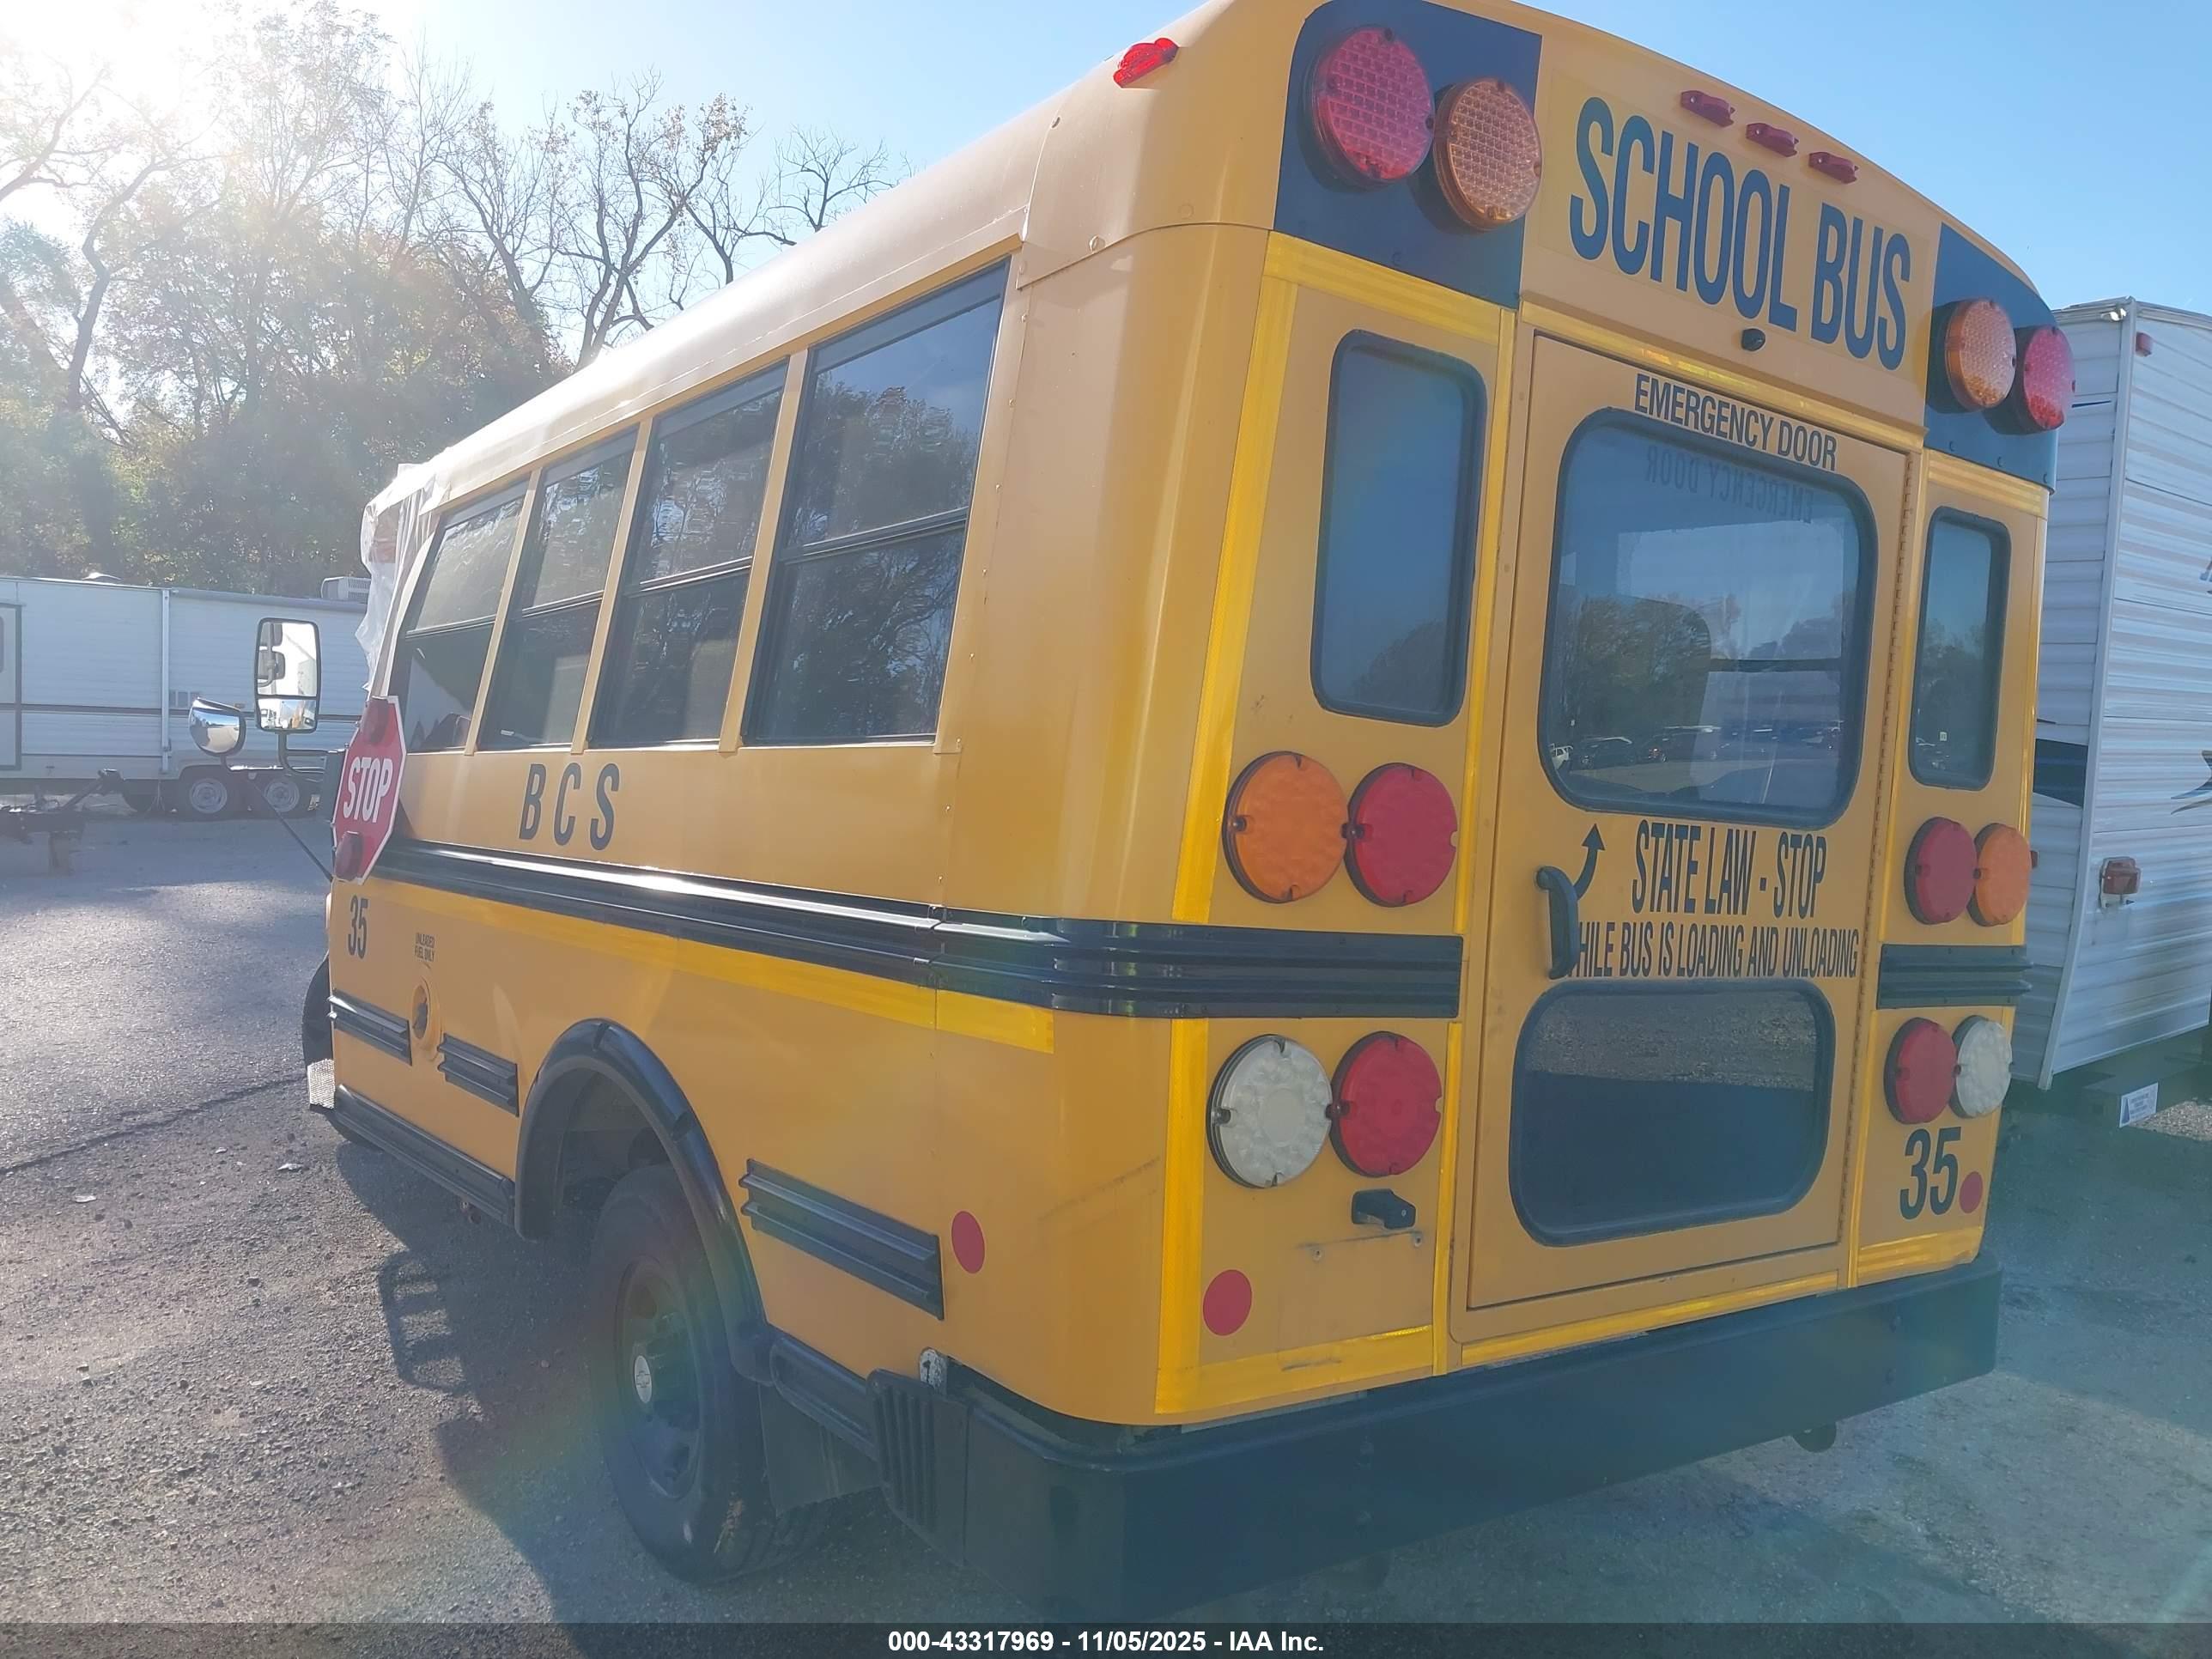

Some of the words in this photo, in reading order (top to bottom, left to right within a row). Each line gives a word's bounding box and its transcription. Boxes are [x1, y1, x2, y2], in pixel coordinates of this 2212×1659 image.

[1570, 97, 1797, 331] SCHOOL
[1811, 203, 1911, 370] BUS
[1634, 374, 1773, 452] EMERGENCY
[1778, 425, 1837, 471] DOOR
[343, 757, 392, 823] STOP
[1632, 819, 1701, 914] STATE
[1705, 827, 1757, 915] LAW
[1773, 831, 1826, 919] STOP
[348, 895, 368, 958] 35
[1568, 921, 1615, 977] HILE
[1620, 921, 1653, 977] BUS
[1658, 922, 1674, 977] IS
[1677, 923, 1744, 977] LOADING
[1747, 927, 1779, 977] AND
[1783, 927, 1859, 978] UNLOADING
[1899, 1127, 1961, 1220] 35
